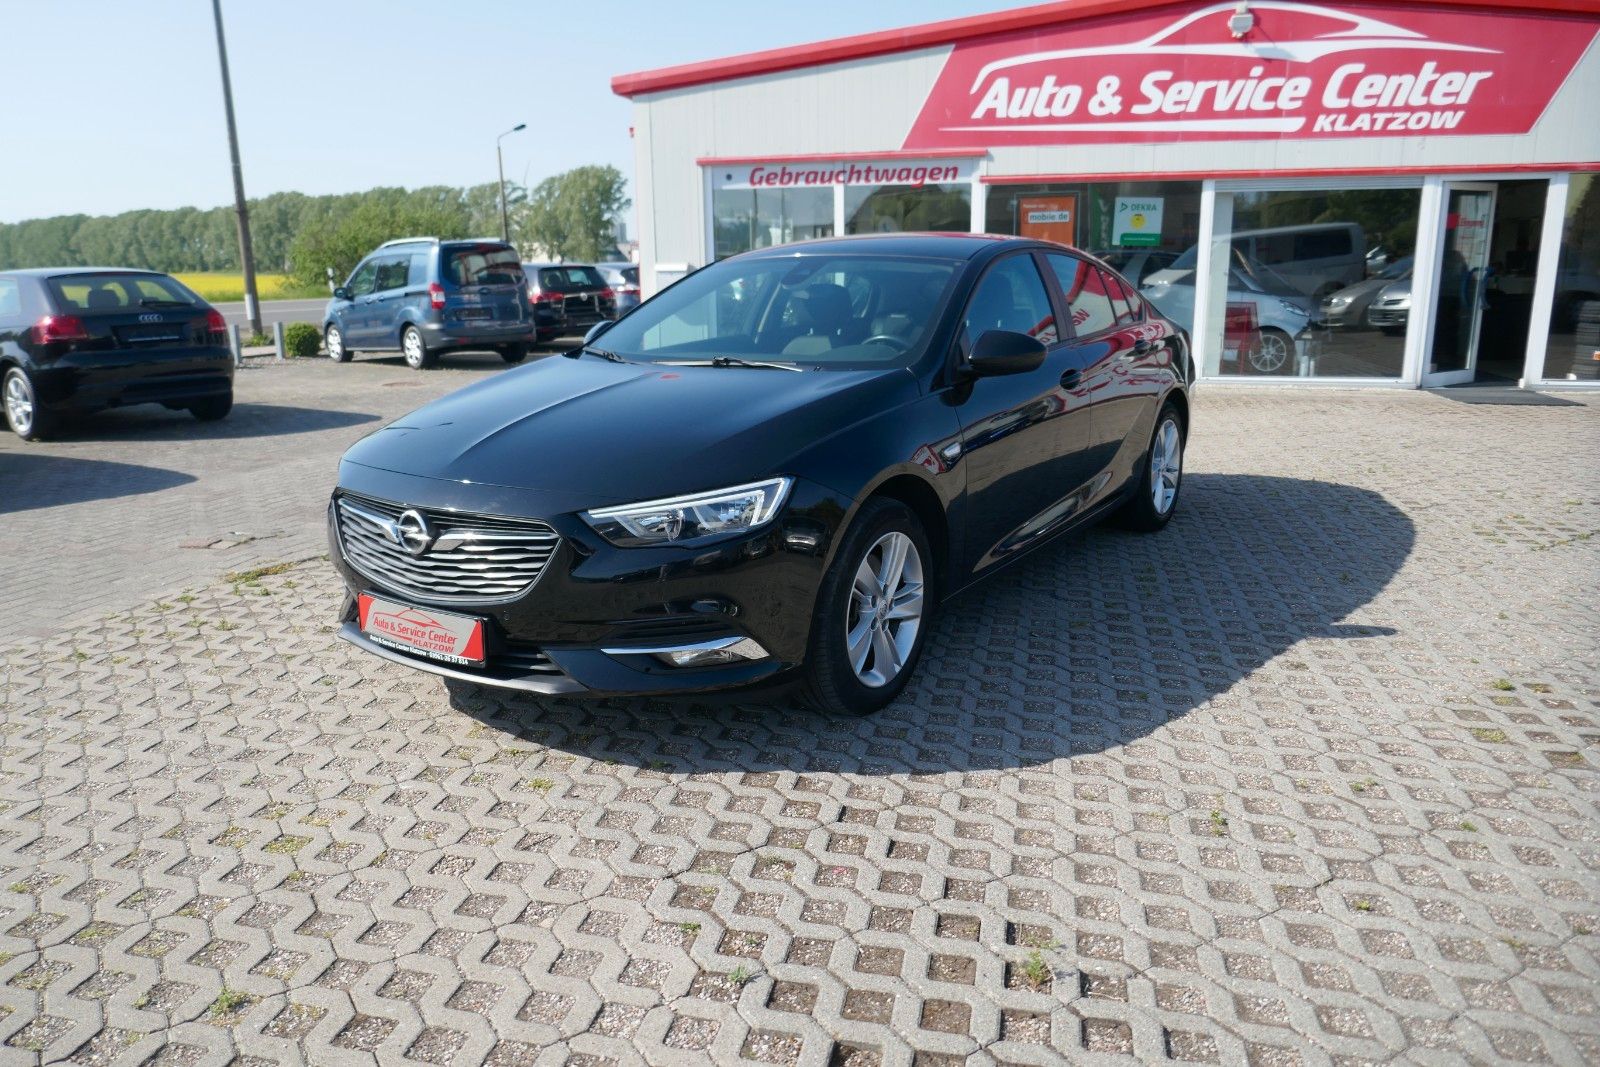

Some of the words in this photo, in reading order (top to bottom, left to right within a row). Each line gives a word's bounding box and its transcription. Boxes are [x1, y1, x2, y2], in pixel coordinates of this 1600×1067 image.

[970, 75, 1082, 119] Auto
[1088, 75, 1122, 116] &
[1130, 65, 1312, 115] Service
[1321, 61, 1494, 109] Center
[1312, 110, 1466, 133] KLATZOW
[749, 164, 959, 188] Gebrauchtwagen
[1131, 203, 1157, 211] DEKRA
[373, 616, 388, 630] Auto
[389, 622, 395, 632] &
[397, 623, 427, 638] Service
[428, 630, 458, 645] Center
[413, 639, 454, 653] KLATZOW
